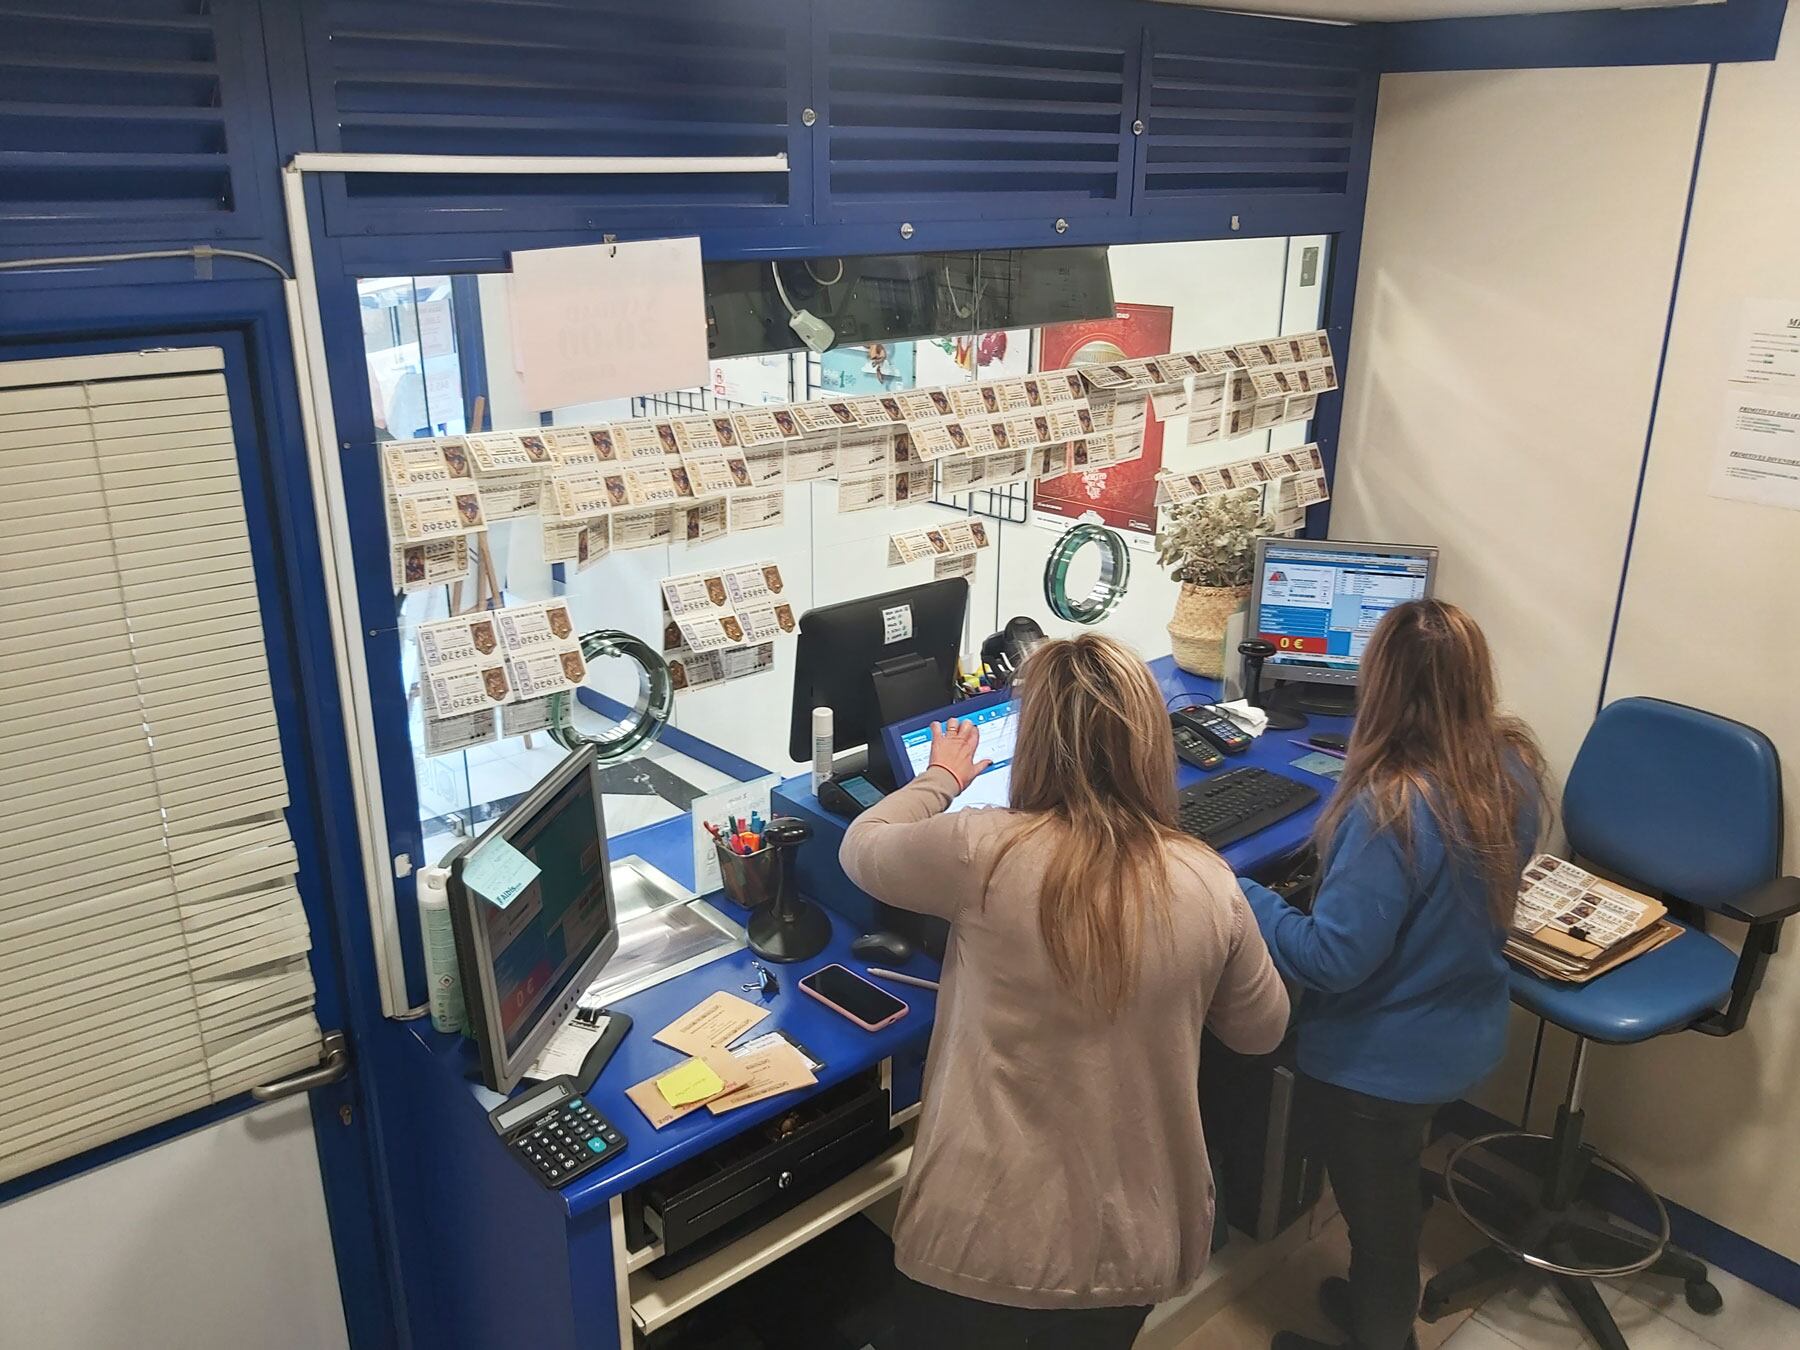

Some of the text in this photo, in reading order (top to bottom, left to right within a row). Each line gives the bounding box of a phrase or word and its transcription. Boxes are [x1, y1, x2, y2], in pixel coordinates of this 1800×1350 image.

[410, 470, 447, 483] 20260
[422, 520, 459, 534] 20260
[1280, 637, 1304, 650] 0 €
[440, 647, 474, 661] 39270
[452, 693, 487, 708] 39270
